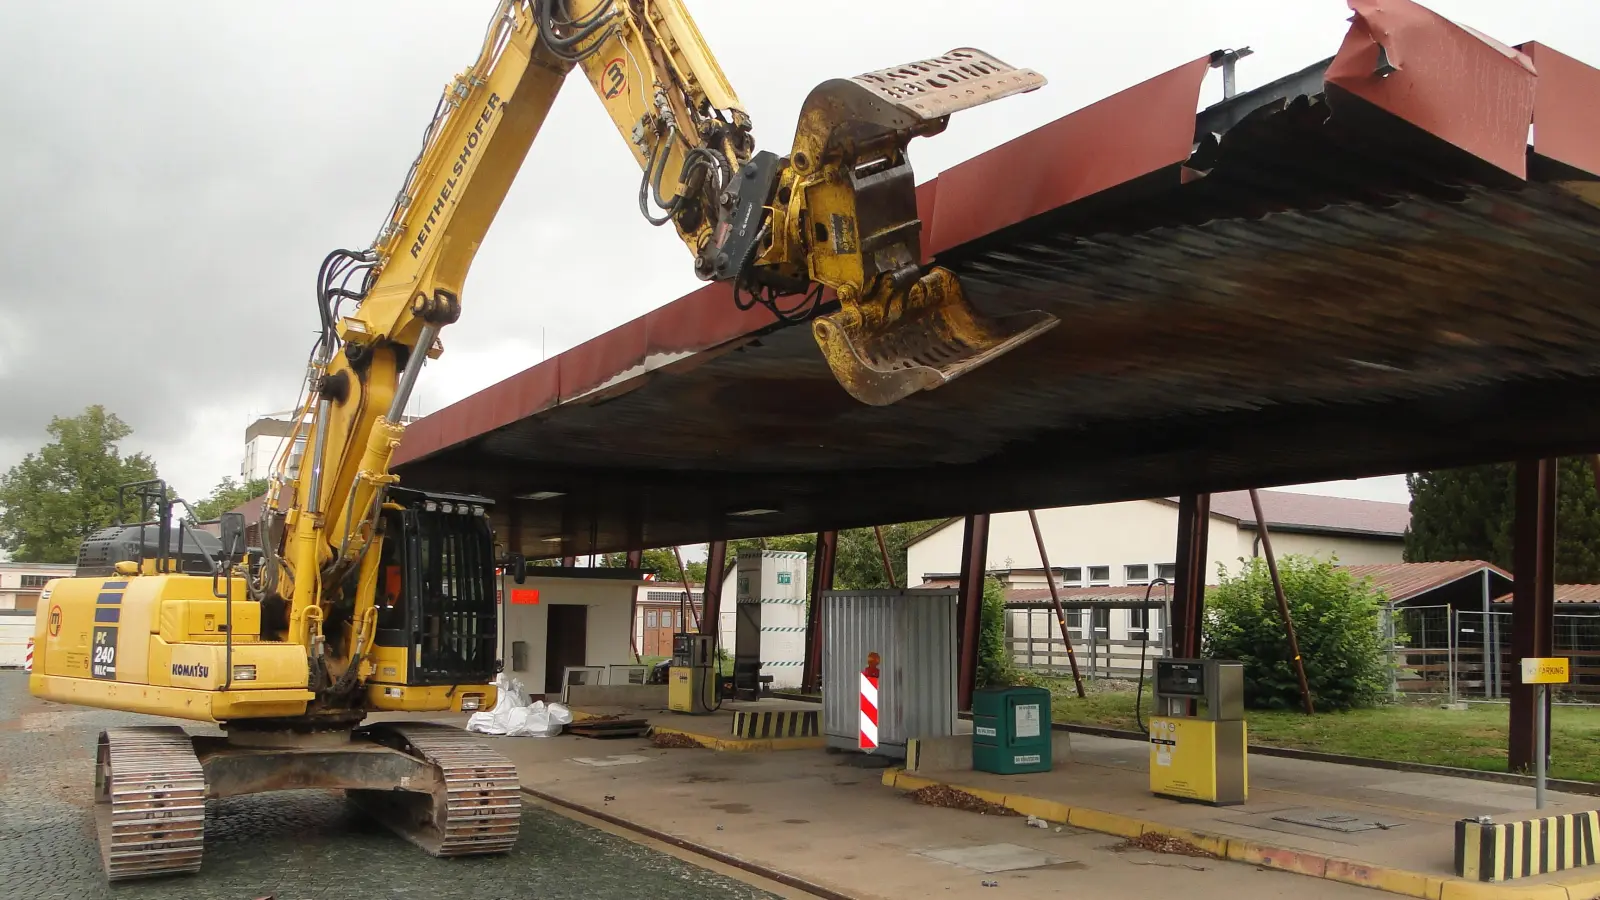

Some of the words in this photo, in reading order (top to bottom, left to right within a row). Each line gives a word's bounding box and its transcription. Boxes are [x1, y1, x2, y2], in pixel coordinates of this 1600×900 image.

[410, 92, 500, 260] REITHELSHÖFER
[96, 631, 107, 644] PC
[94, 646, 114, 664] 240
[172, 662, 209, 678] KOMATSU
[1539, 666, 1564, 675] PARKING
